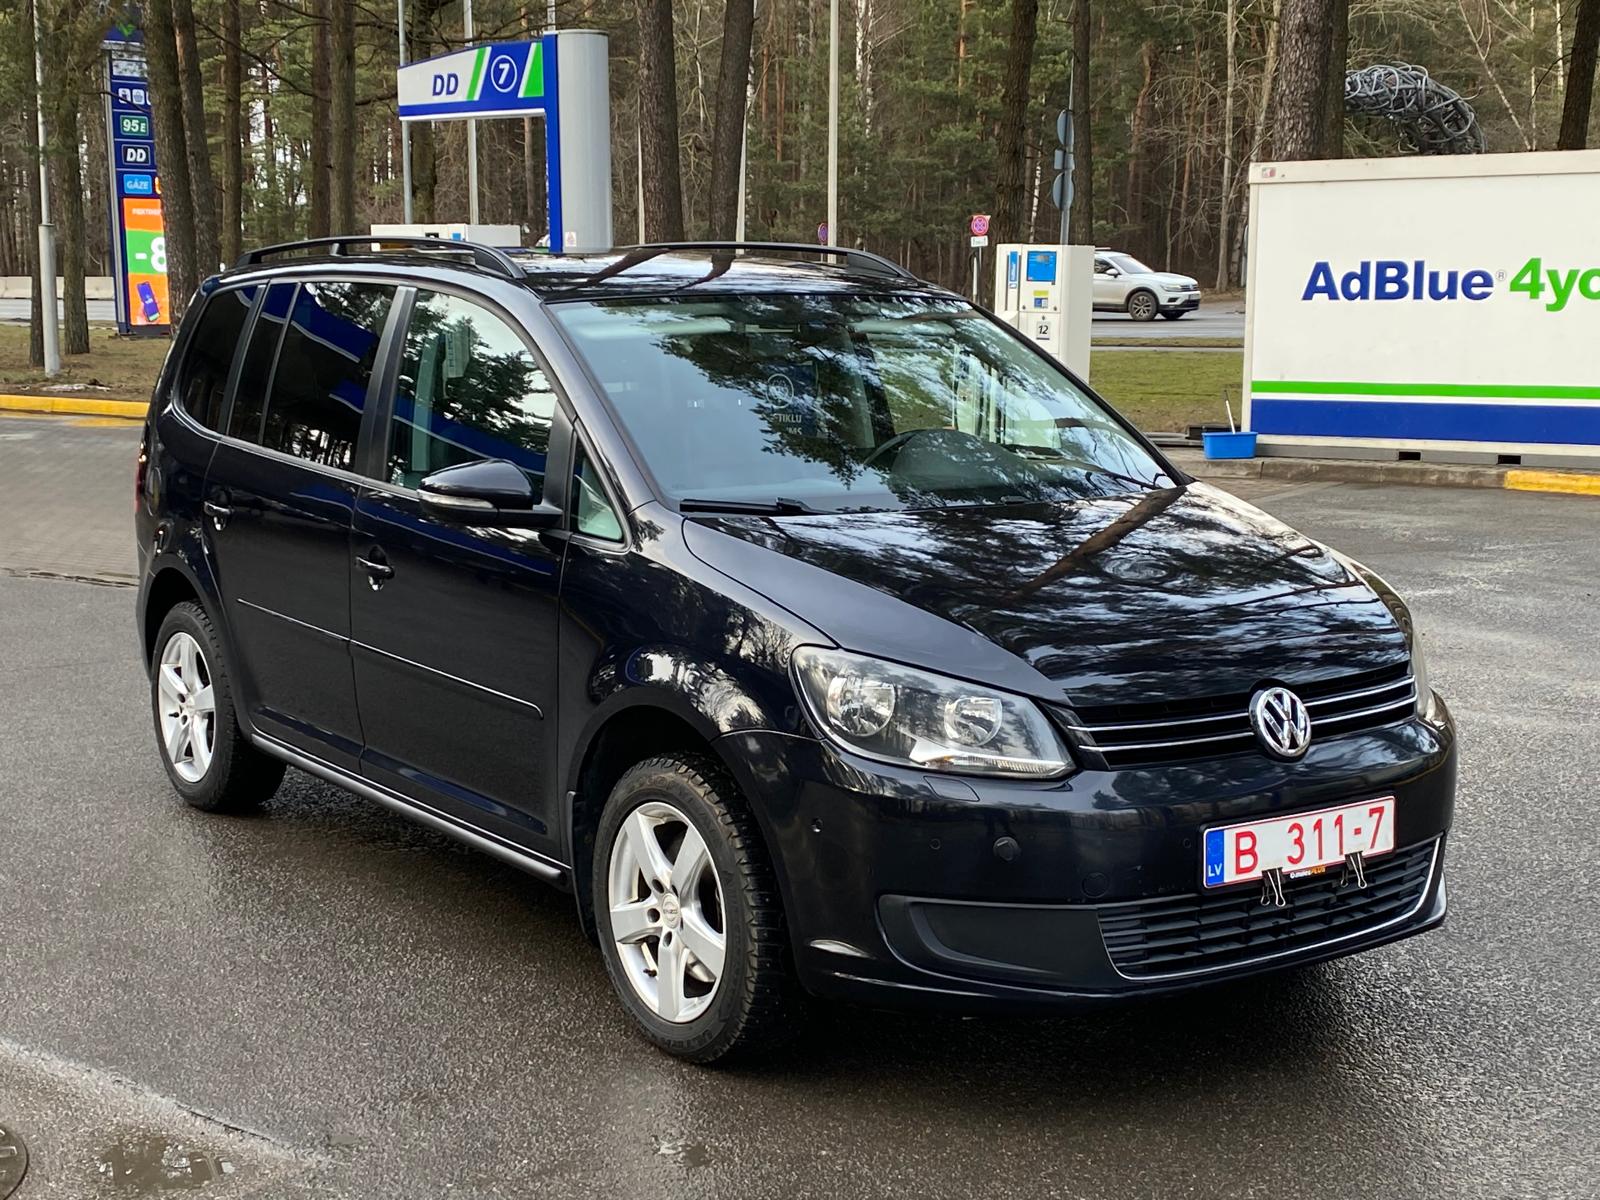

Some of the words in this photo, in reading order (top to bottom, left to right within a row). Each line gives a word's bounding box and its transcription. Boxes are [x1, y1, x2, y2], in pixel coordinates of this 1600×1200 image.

[498, 63, 510, 85] 7
[432, 73, 459, 96] DD
[126, 148, 146, 162] DD
[1038, 325, 1048, 335] 12
[1234, 831, 1259, 875] B
[1287, 806, 1384, 865] 311-7
[1208, 863, 1223, 877] LV
